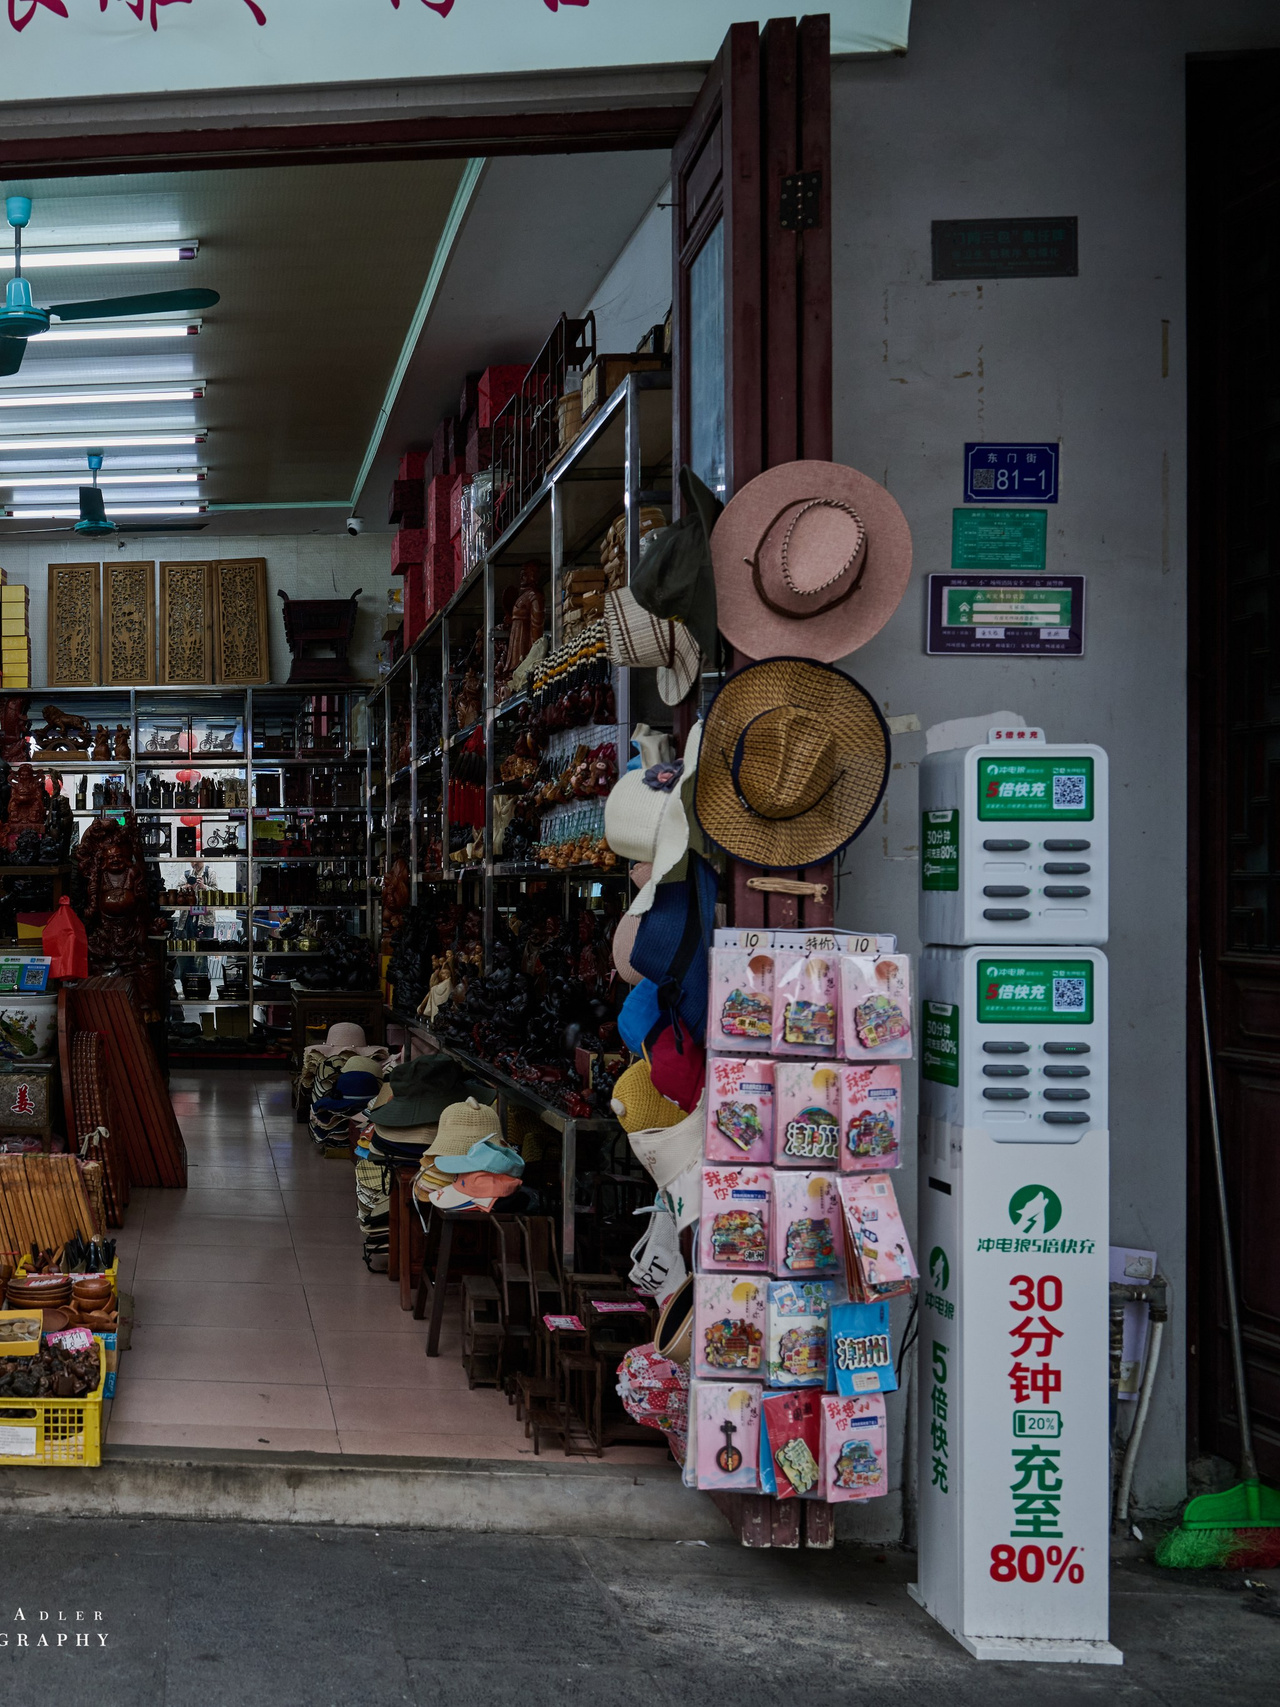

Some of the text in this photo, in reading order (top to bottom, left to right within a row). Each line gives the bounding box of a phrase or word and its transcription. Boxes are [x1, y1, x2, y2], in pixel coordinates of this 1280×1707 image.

[987, 452, 1037, 464] 东门街
[996, 468, 1046, 490] 81-1
[995, 731, 1038, 739] 5倍快充
[986, 781, 1046, 798] 5倍快充
[927, 829, 951, 845] 30分钟
[745, 932, 759, 947] 10
[854, 938, 869, 952] 10
[985, 983, 1046, 1000] 5倍快充
[927, 1020, 951, 1038] 30分钟
[977, 1238, 1096, 1254] 冲电狼5倍快充
[745, 1250, 765, 1261] 潮州
[925, 1290, 955, 1320] 冲电狼
[1008, 1275, 1064, 1404] 30分钟
[837, 1335, 890, 1370] 潮州
[931, 1340, 949, 1494] 5倍快充
[1028, 1418, 1055, 1430] 20%
[1010, 1444, 1063, 1538] 充至
[990, 1544, 1084, 1584] 80%
